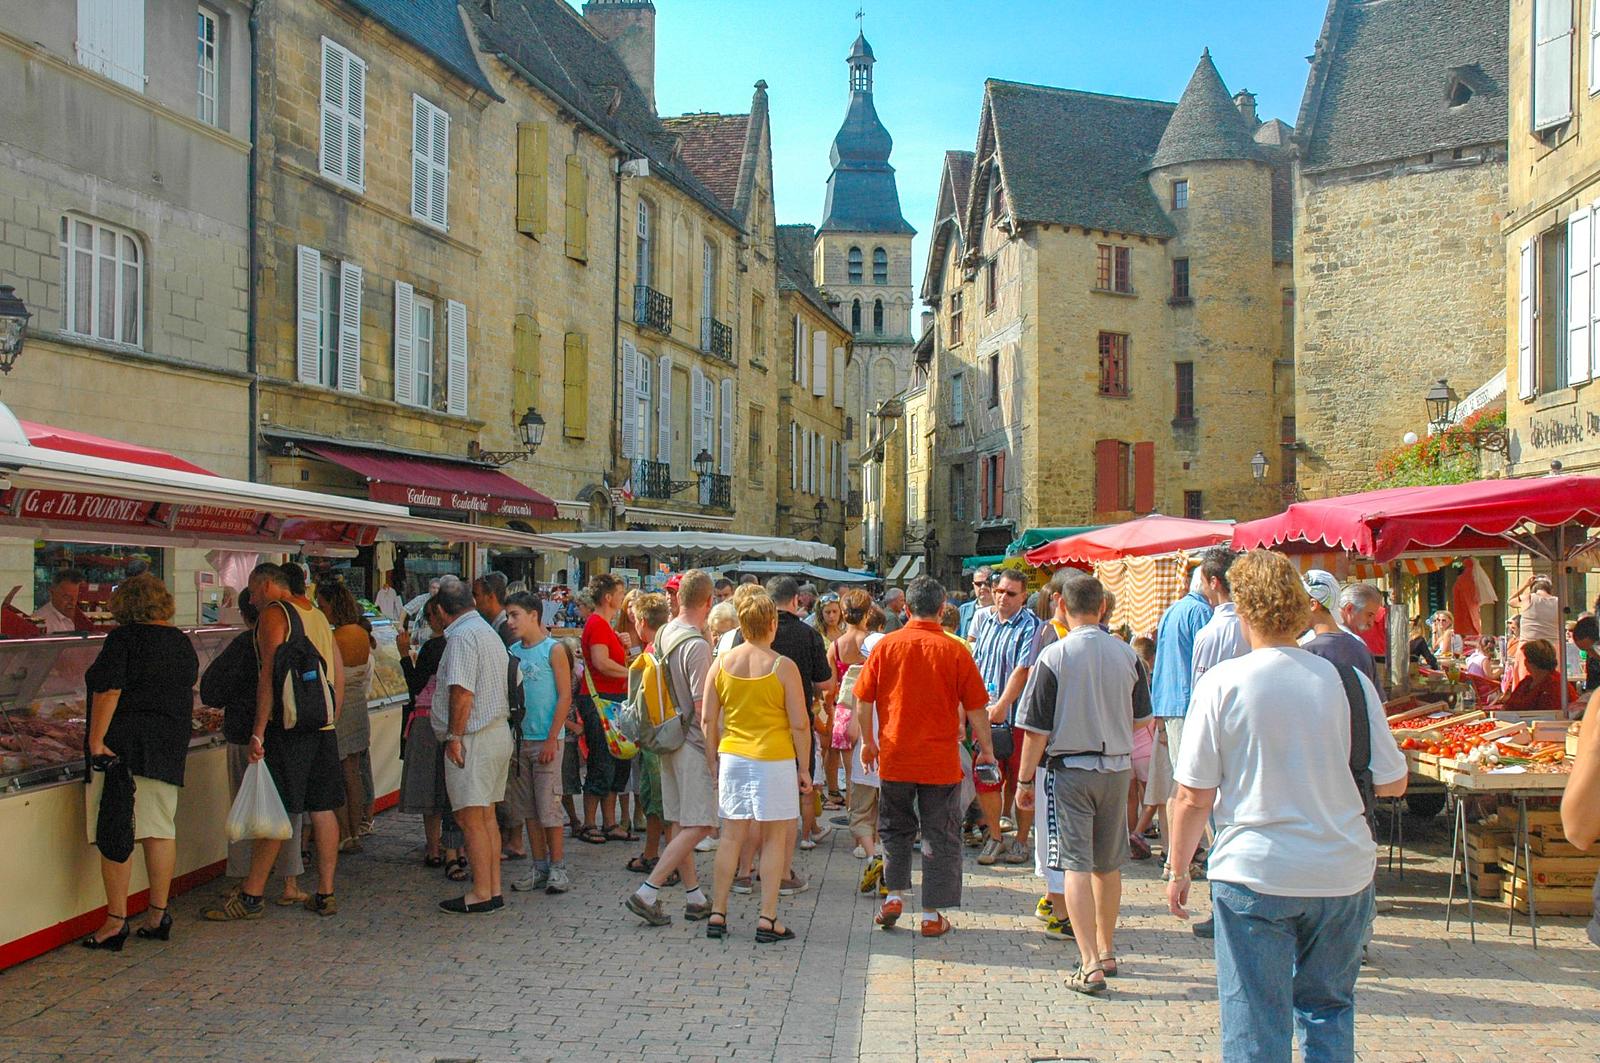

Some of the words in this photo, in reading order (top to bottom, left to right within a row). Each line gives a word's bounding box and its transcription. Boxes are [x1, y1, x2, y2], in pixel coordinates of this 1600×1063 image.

[25, 490, 41, 512] G.
[42, 498, 55, 514] et
[56, 493, 77, 515] Th.
[78, 496, 142, 520] FOURNET
[407, 488, 442, 506] Cadeaux
[450, 494, 489, 512] Coutellerie
[497, 499, 532, 516] Souvenirs
